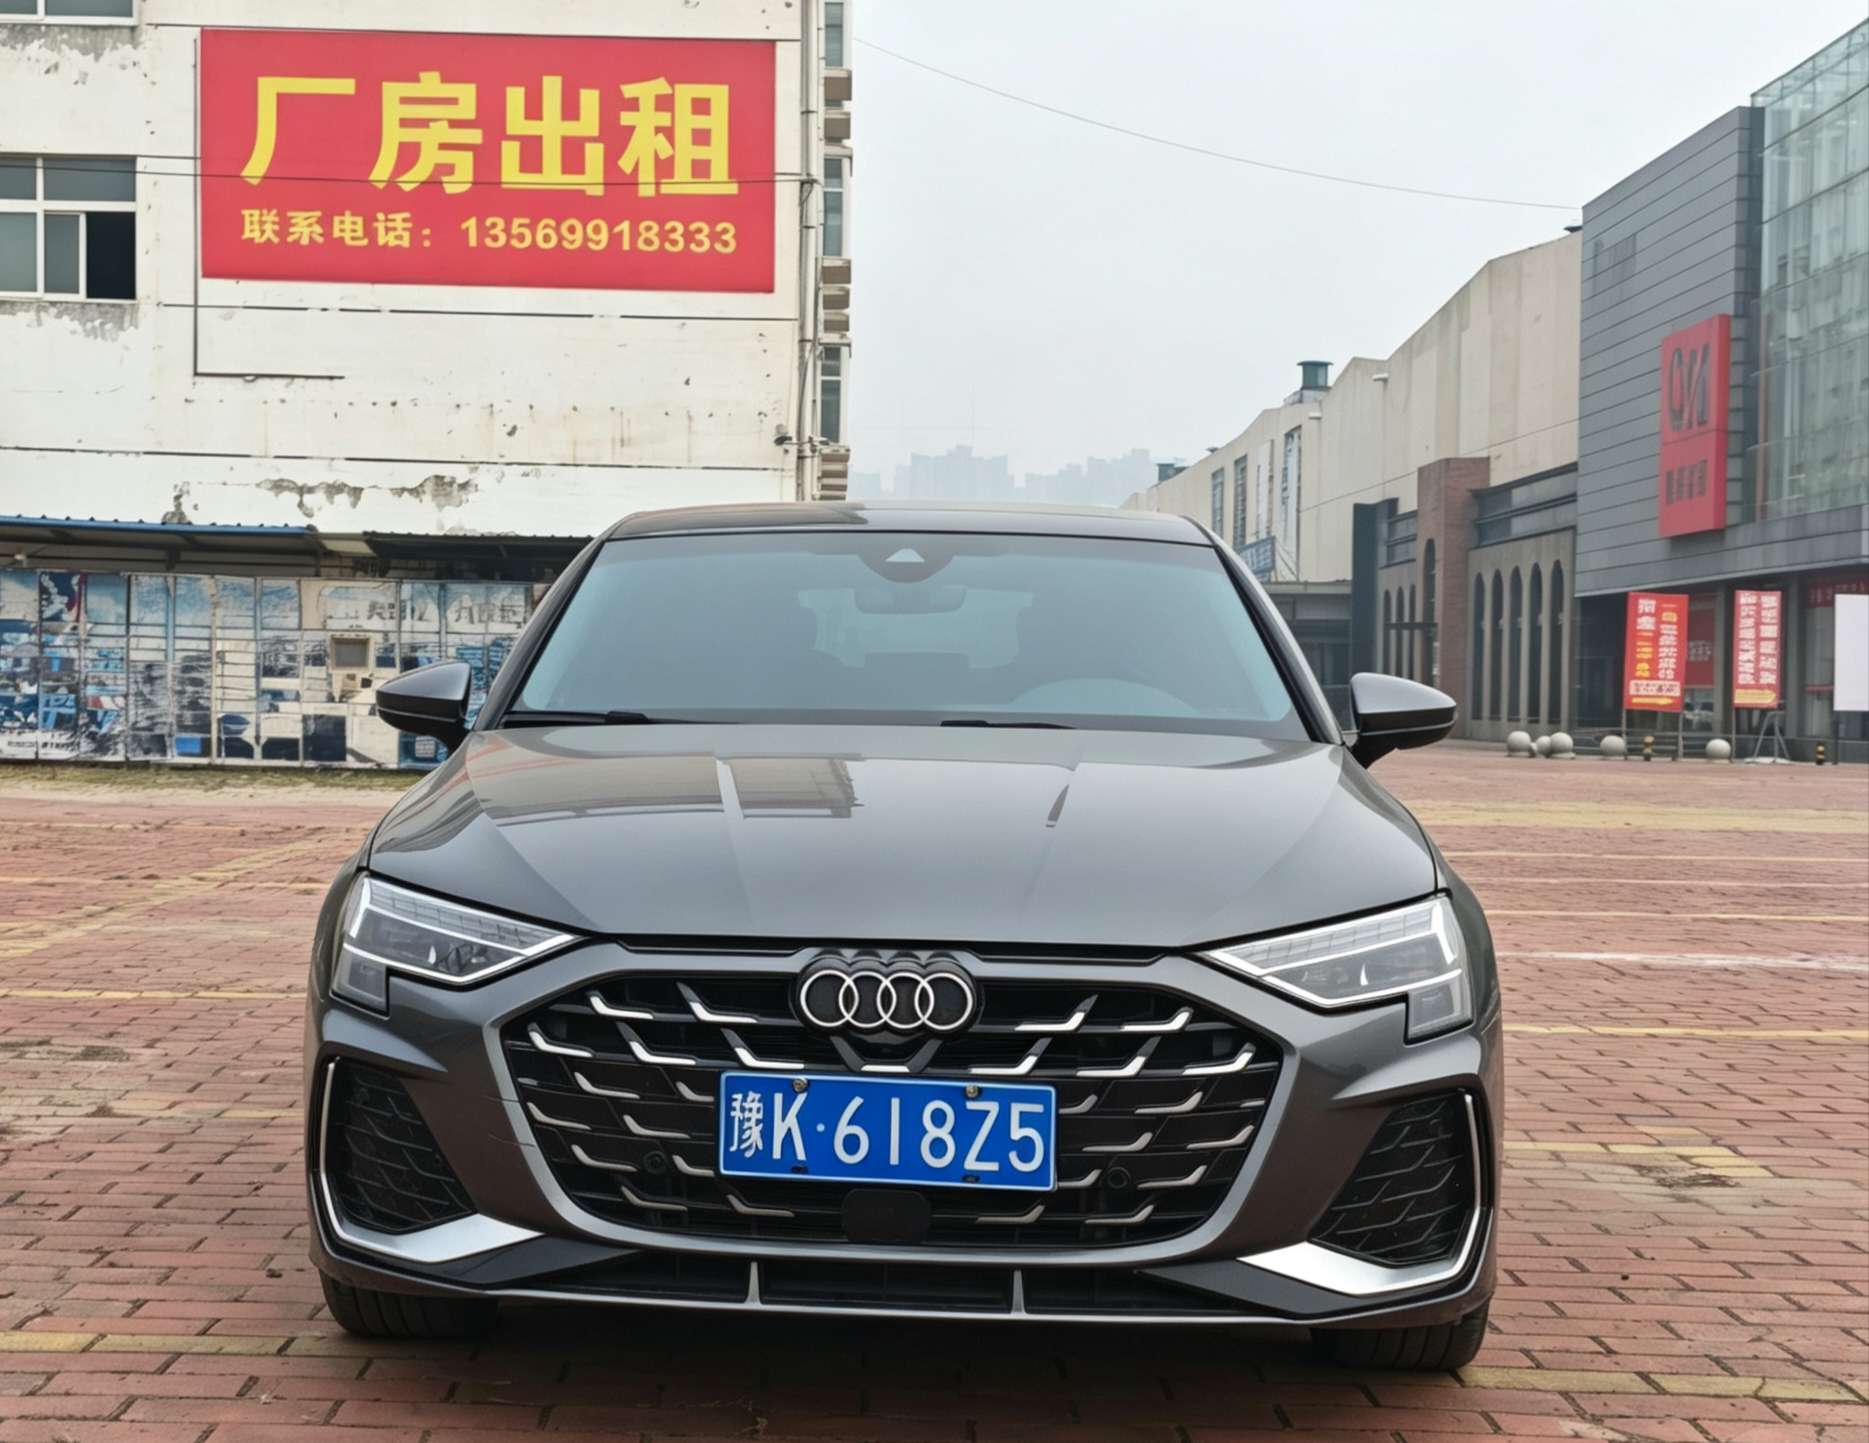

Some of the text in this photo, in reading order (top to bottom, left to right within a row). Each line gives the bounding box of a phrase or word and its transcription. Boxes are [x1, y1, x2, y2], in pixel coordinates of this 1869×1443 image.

[240, 71, 739, 197] 厂房出租
[241, 208, 737, 253] 联系电话： 13569918333
